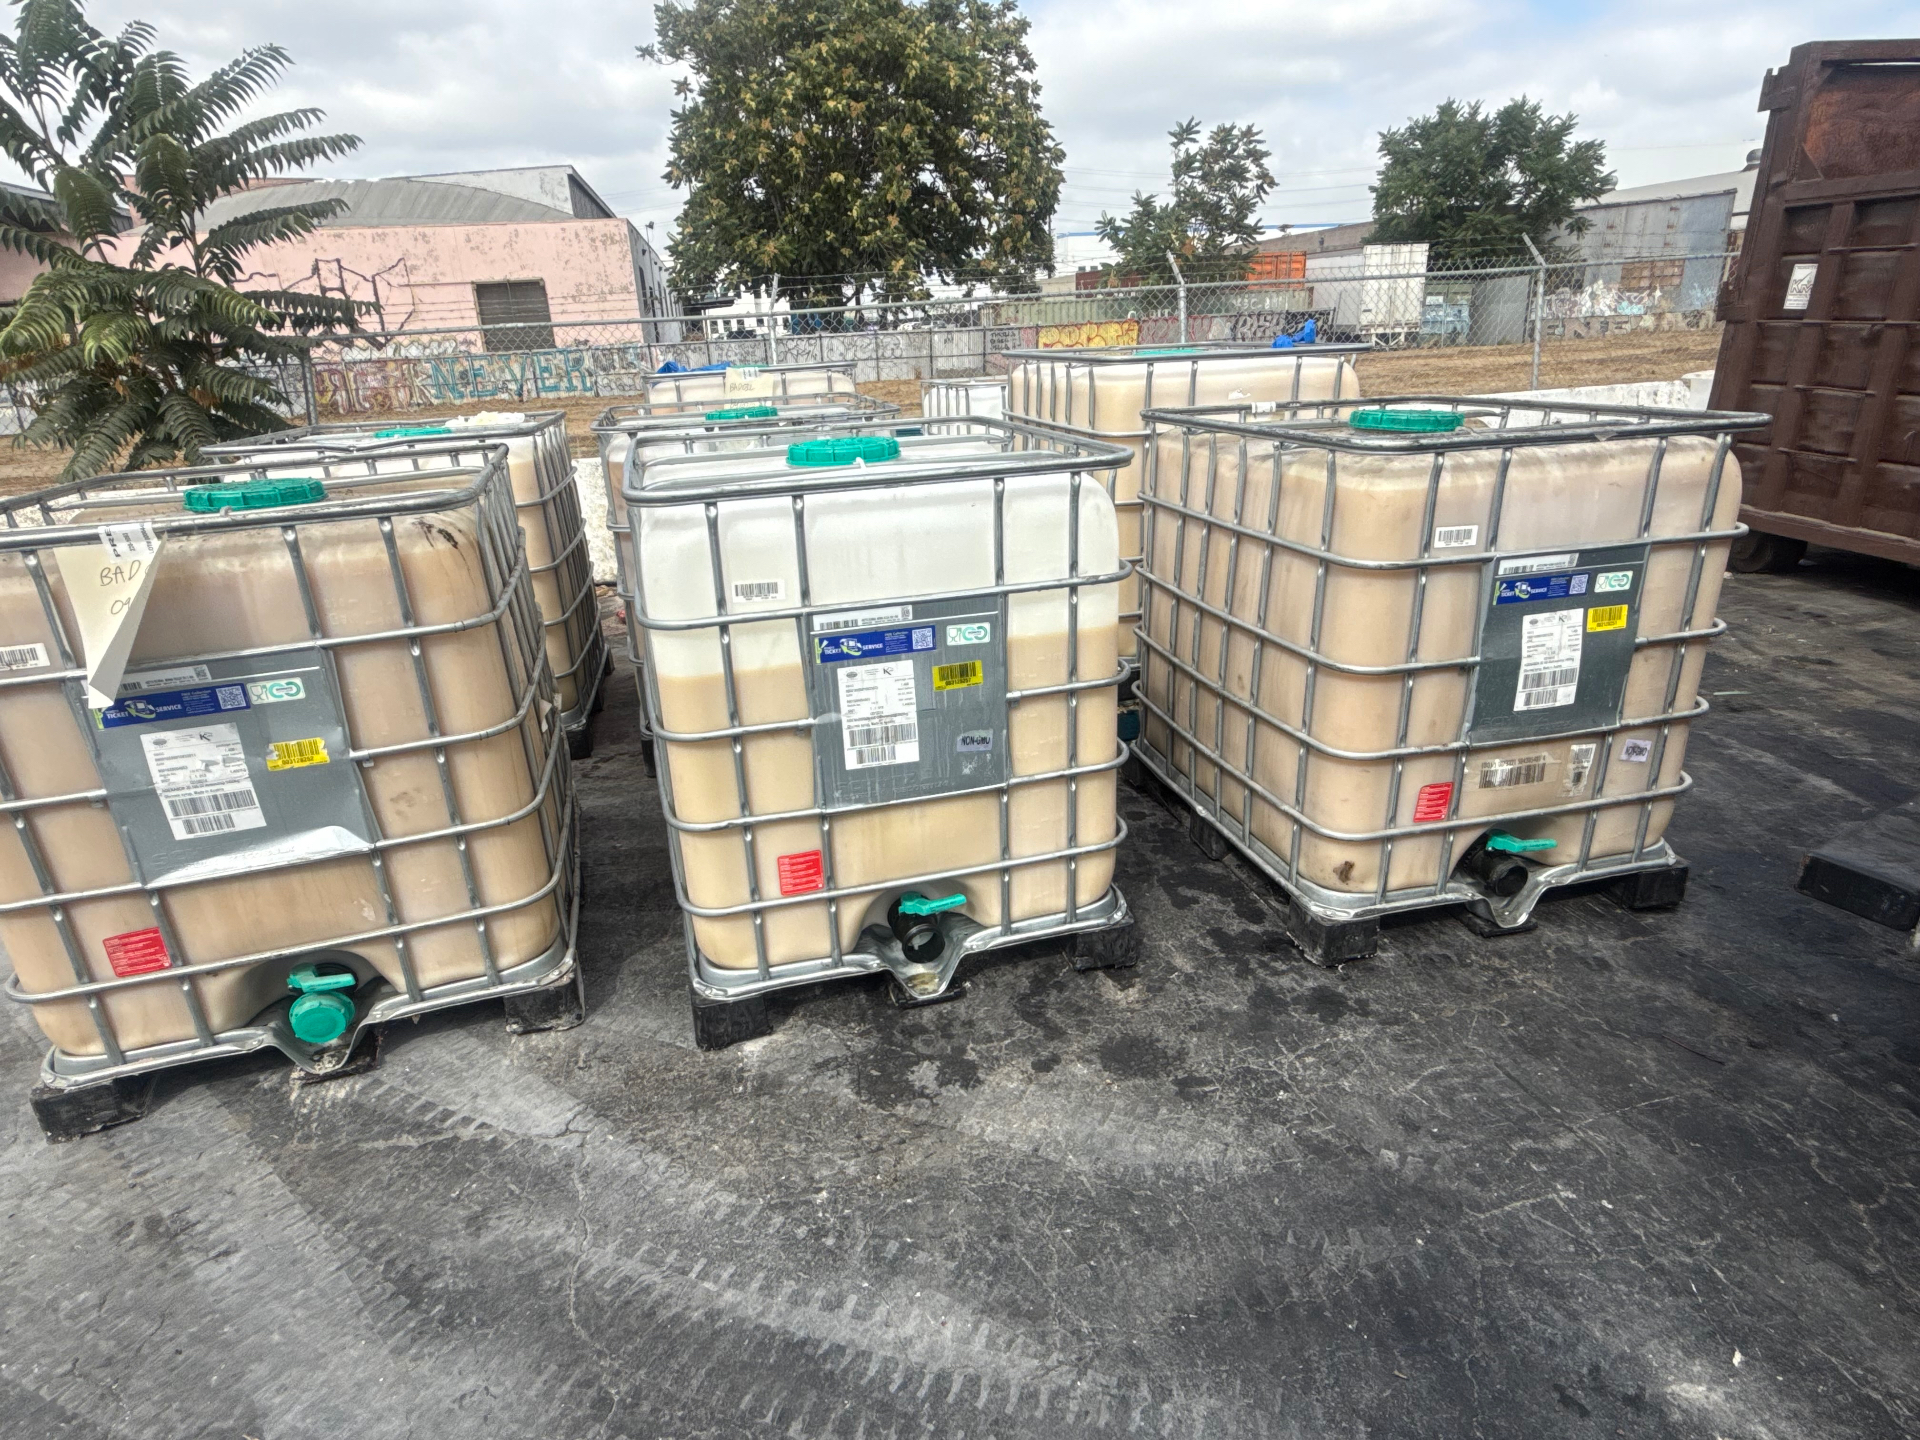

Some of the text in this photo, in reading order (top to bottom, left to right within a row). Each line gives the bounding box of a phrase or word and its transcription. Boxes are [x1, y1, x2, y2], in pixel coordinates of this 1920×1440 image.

[429, 348, 595, 400] NEVER
[100, 559, 142, 587] BAD
[106, 711, 129, 720] TICKET
[155, 703, 182, 713] SERVICE
